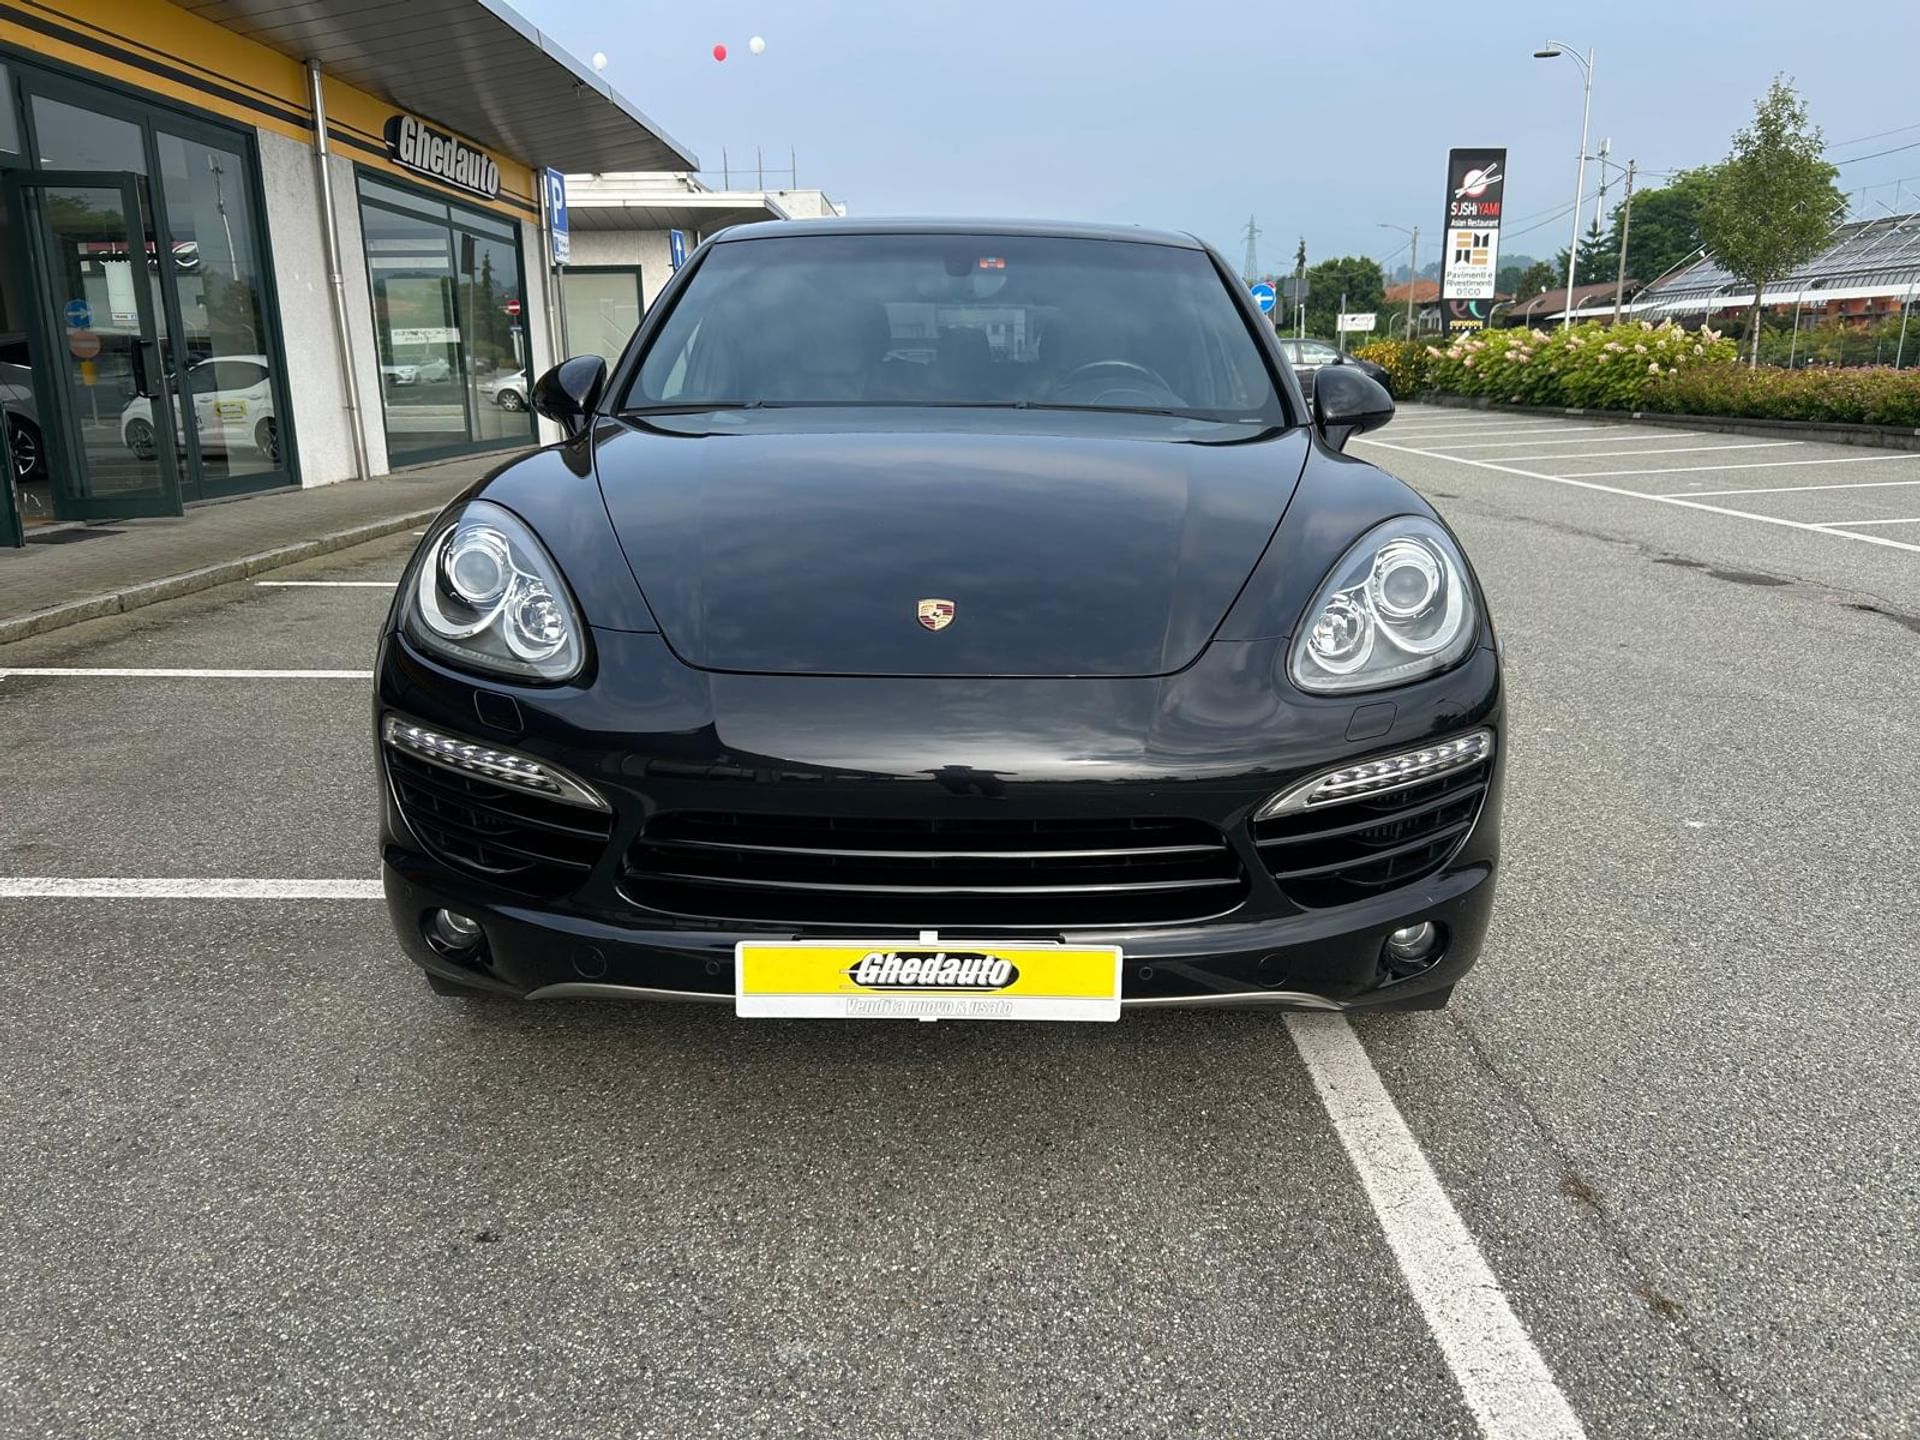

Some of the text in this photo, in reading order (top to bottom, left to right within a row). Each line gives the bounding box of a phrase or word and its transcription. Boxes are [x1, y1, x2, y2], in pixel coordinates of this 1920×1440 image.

[400, 115, 499, 195] Ghedauto
[551, 176, 563, 225] P
[1478, 202, 1500, 216] YAMI
[1450, 219, 1499, 227] Asian Restaurant
[1446, 271, 1487, 280] Pavimenti
[856, 952, 1012, 986] Ghedauto
[847, 998, 1014, 1016] Vendita nuovo & usato
